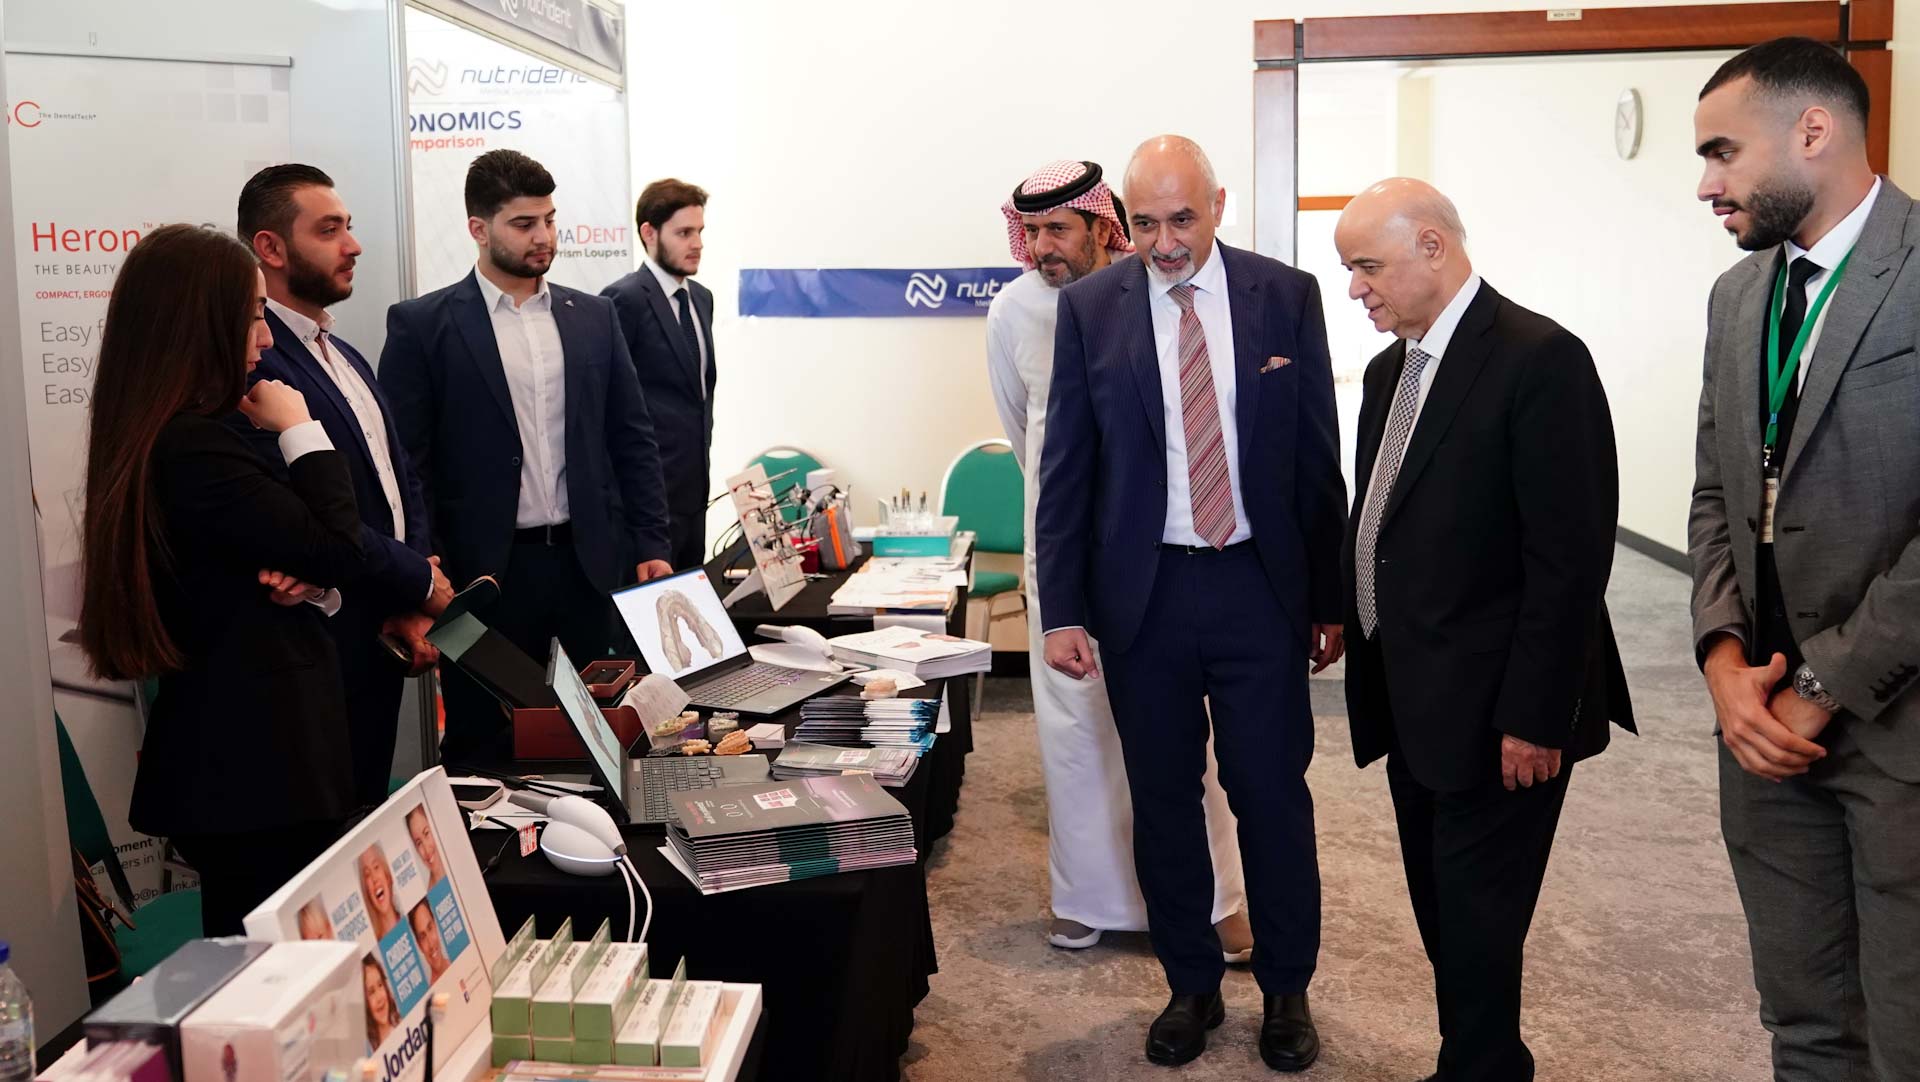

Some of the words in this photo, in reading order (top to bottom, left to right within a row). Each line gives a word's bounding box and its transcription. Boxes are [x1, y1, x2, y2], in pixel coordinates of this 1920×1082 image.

[556, 249, 583, 258] rism
[584, 247, 628, 259] Loupes
[34, 264, 60, 276] THE
[66, 264, 116, 275] BEAUTY
[35, 290, 82, 301] COMPACT,
[40, 321, 93, 348] Easy
[42, 353, 93, 378] Easy
